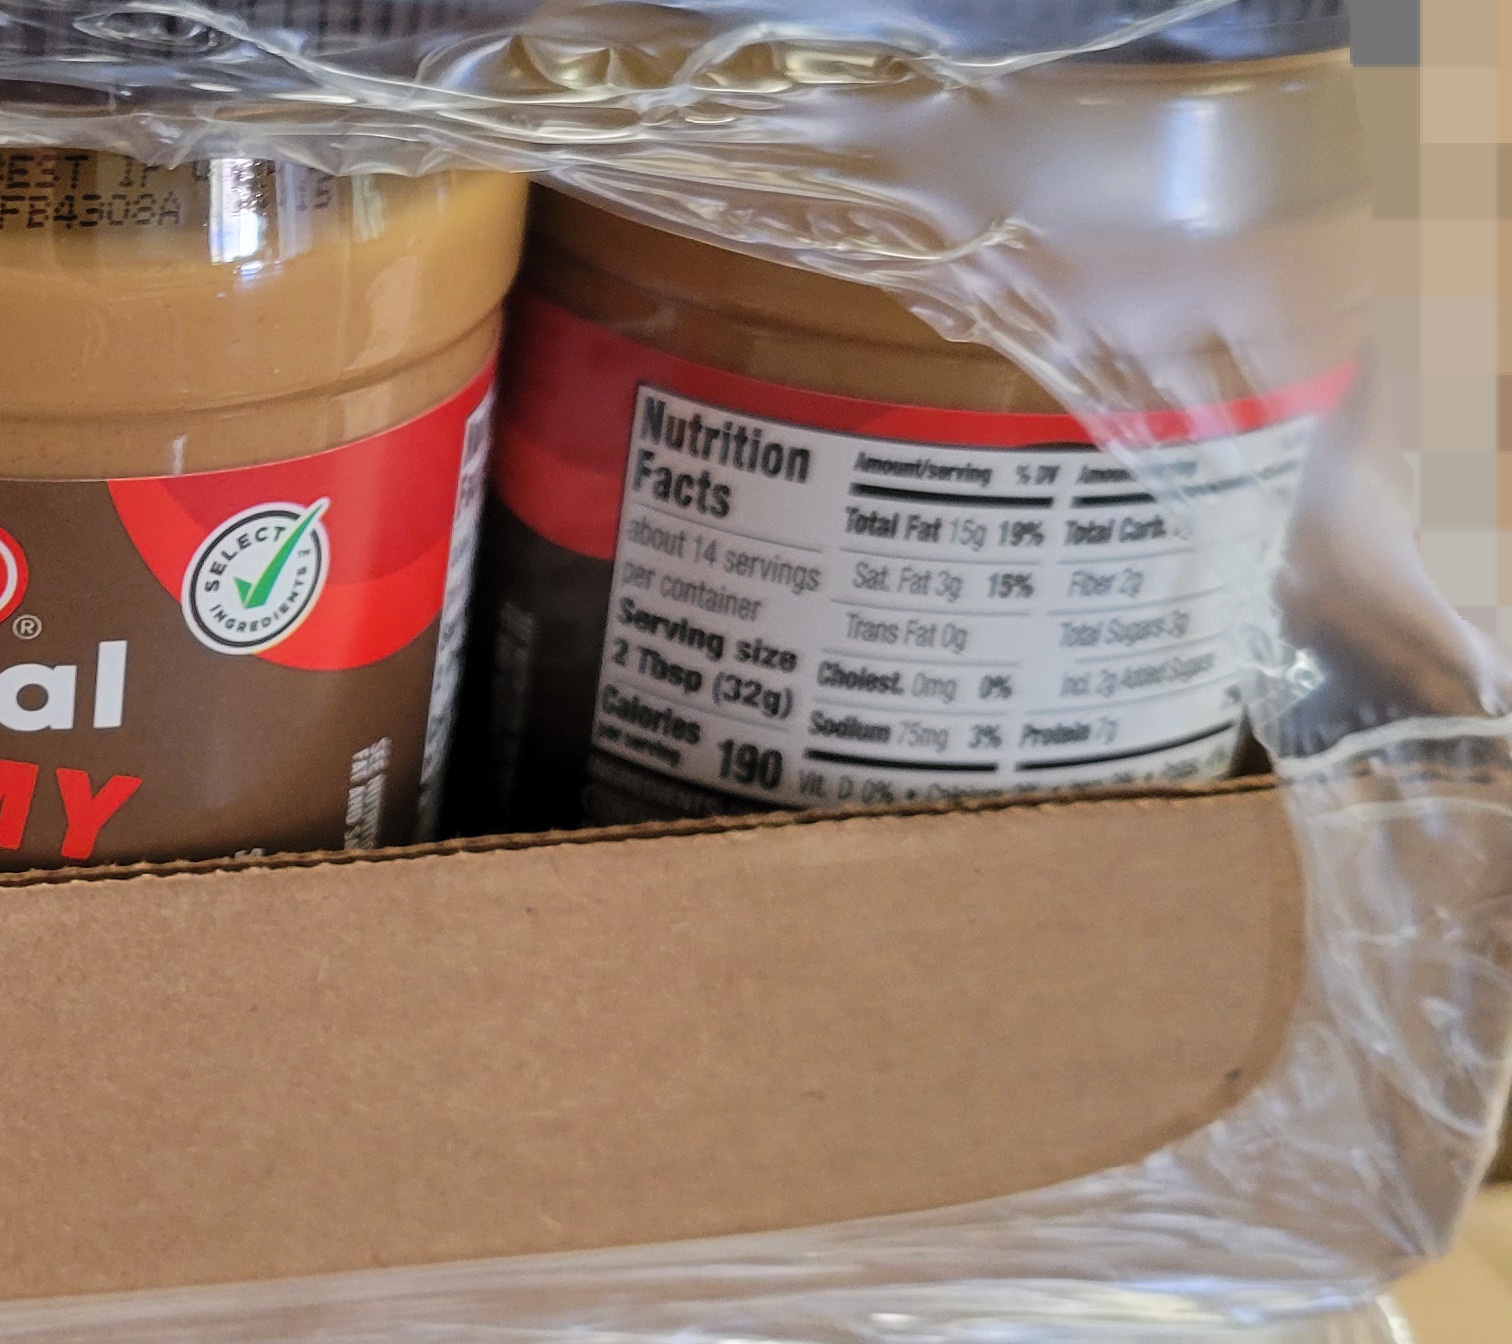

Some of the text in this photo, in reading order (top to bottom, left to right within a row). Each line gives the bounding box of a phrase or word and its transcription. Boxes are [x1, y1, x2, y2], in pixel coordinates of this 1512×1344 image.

[640, 396, 812, 485] Nutrition
[632, 448, 732, 518] Facts
[204, 526, 286, 593] SELECT
[628, 516, 822, 595] about 14 servings
[845, 506, 1046, 552] Total Fat 15g 19%
[209, 565, 308, 633] INGREDIENTS
[659, 574, 762, 622] container
[897, 566, 933, 596] Fat
[617, 596, 799, 673] Serving size
[846, 612, 900, 646] Trans
[902, 618, 938, 649] Fat
[612, 636, 794, 721] 2 Tbsp (32g)
[601, 683, 701, 746] Calories
[718, 737, 784, 791] 190
